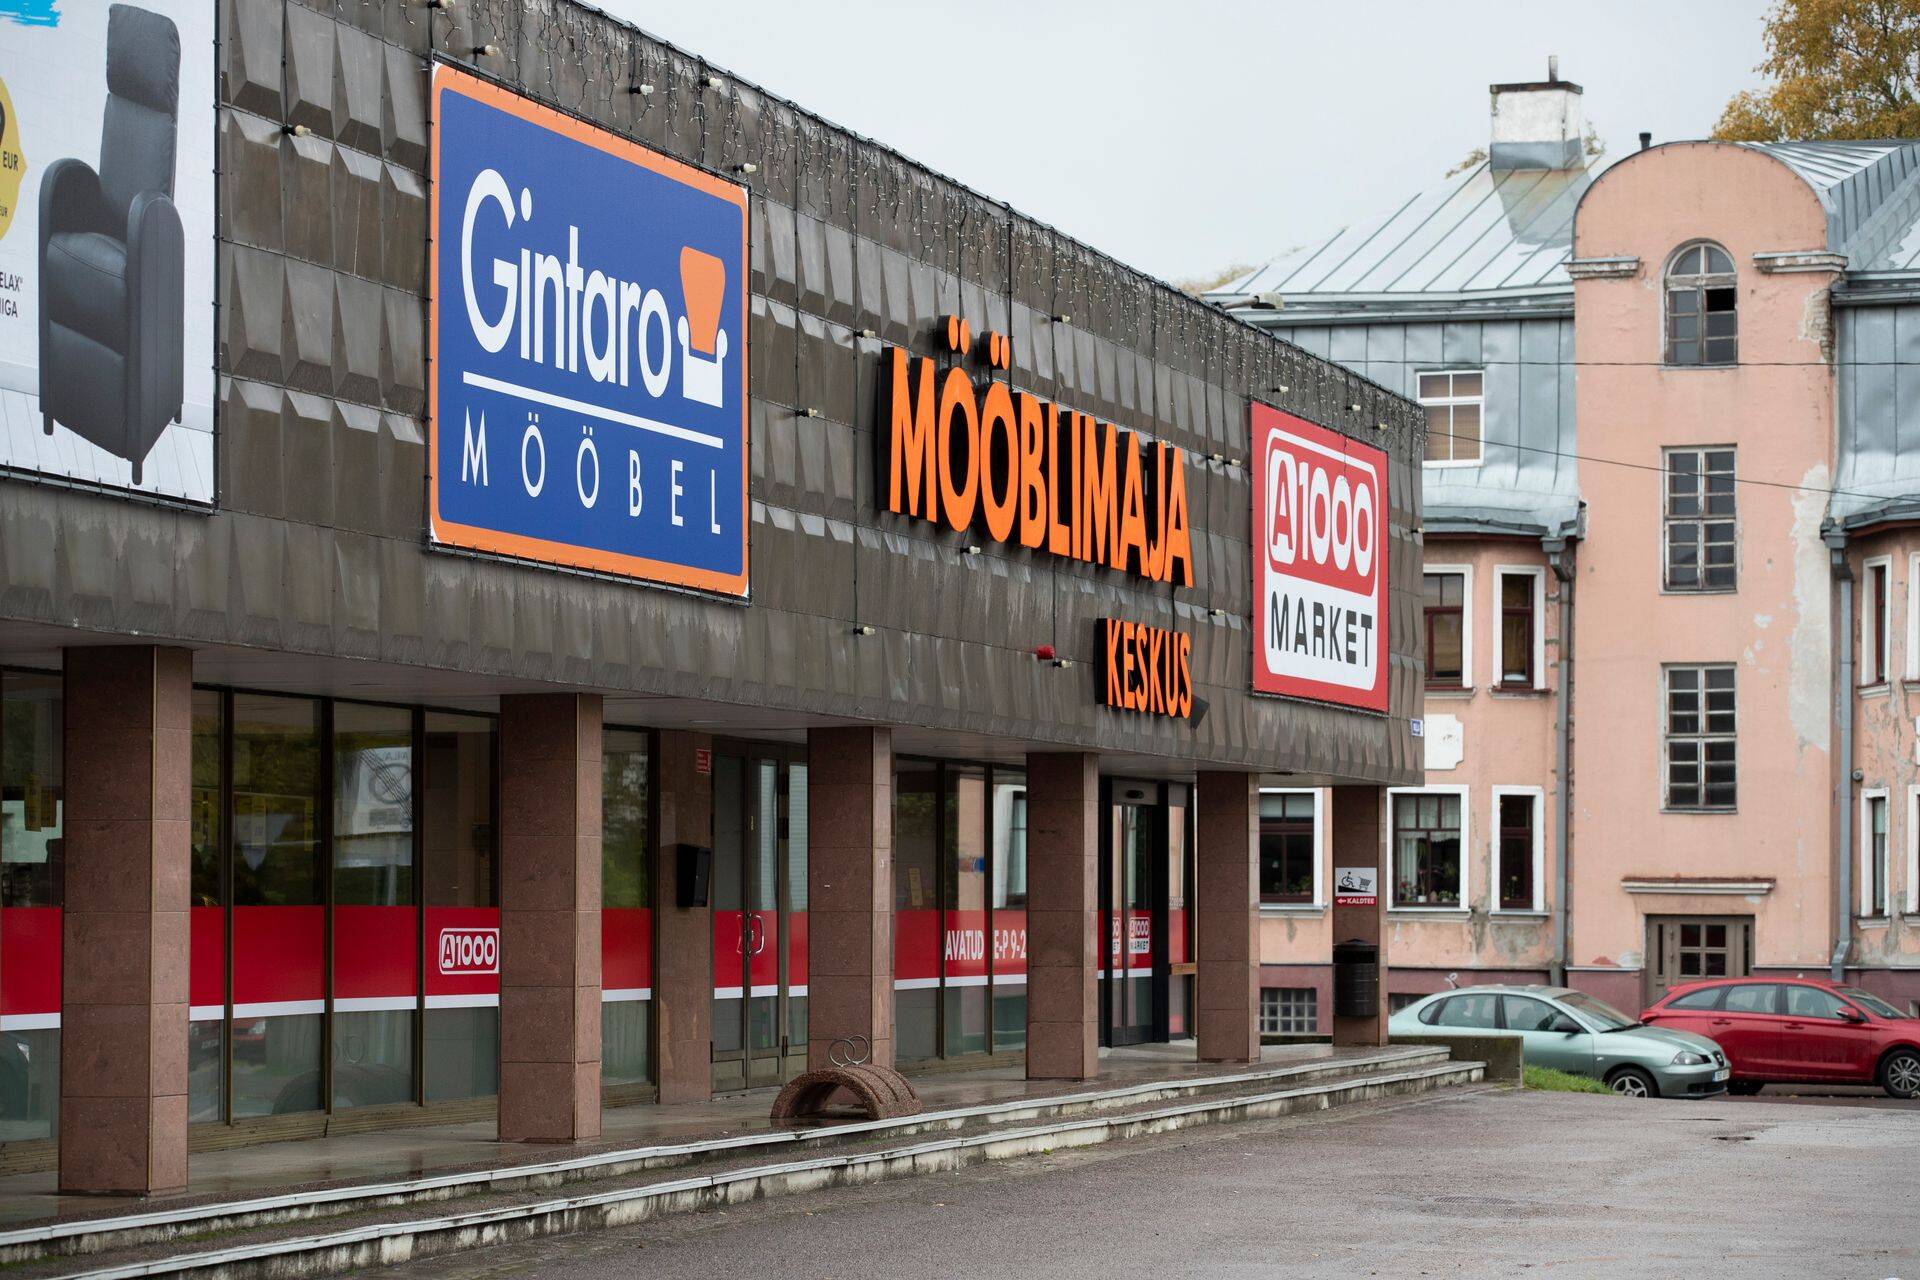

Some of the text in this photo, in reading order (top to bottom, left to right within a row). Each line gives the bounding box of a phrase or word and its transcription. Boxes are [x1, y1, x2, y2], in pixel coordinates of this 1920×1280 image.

[3, 151, 18, 171] EUR
[461, 168, 672, 398] Gintaro
[461, 405, 721, 534] MÖÖBEL
[889, 314, 1193, 588] MÖÖBLIMAJA
[1268, 448, 1373, 577] A1000
[1106, 617, 1191, 720] KESKUS
[1270, 590, 1373, 668] MARKET
[442, 934, 496, 968] A1000
[945, 930, 985, 961] AVATUD
[994, 929, 1009, 959] E-P
